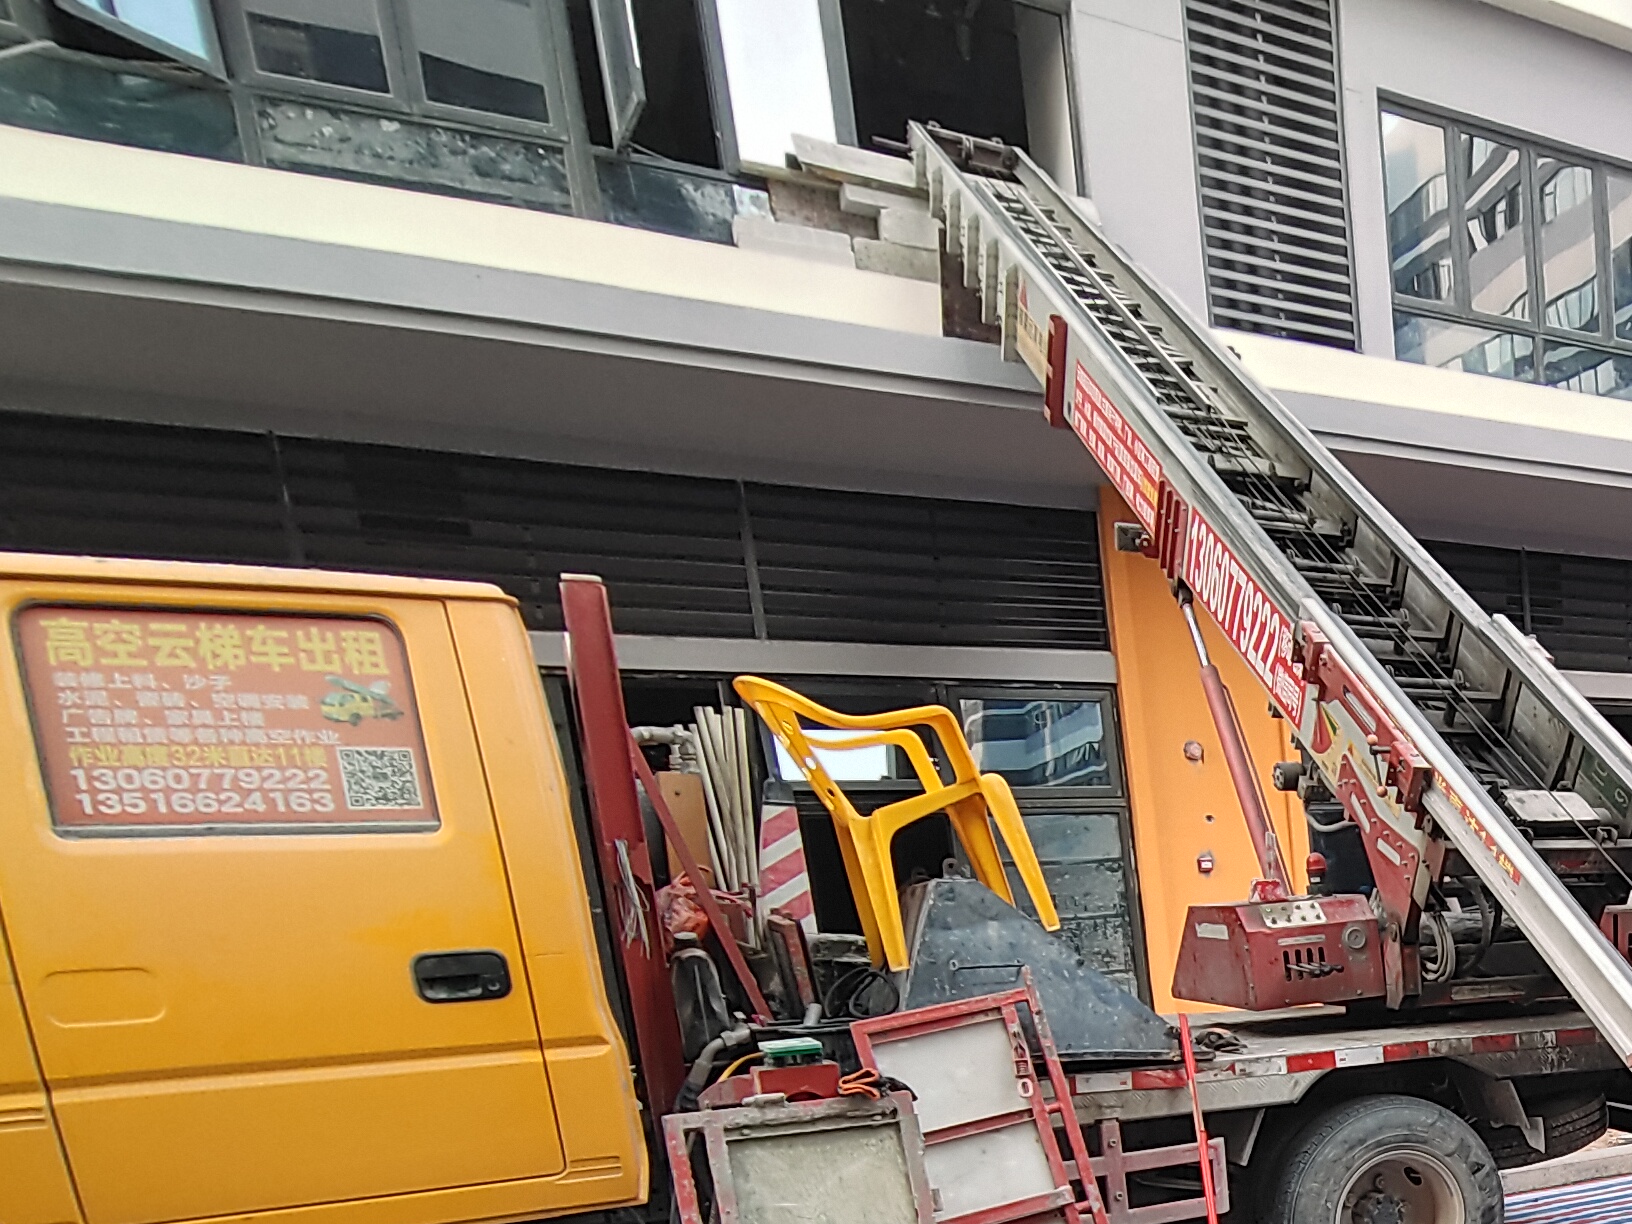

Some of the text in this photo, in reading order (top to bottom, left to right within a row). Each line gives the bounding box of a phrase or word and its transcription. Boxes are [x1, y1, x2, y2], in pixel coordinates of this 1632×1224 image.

[1189, 514, 1280, 689] 13060779222
[39, 617, 390, 675] 高空云梯车出租
[70, 768, 332, 790] 13060779222
[75, 791, 335, 815] 13516624163
